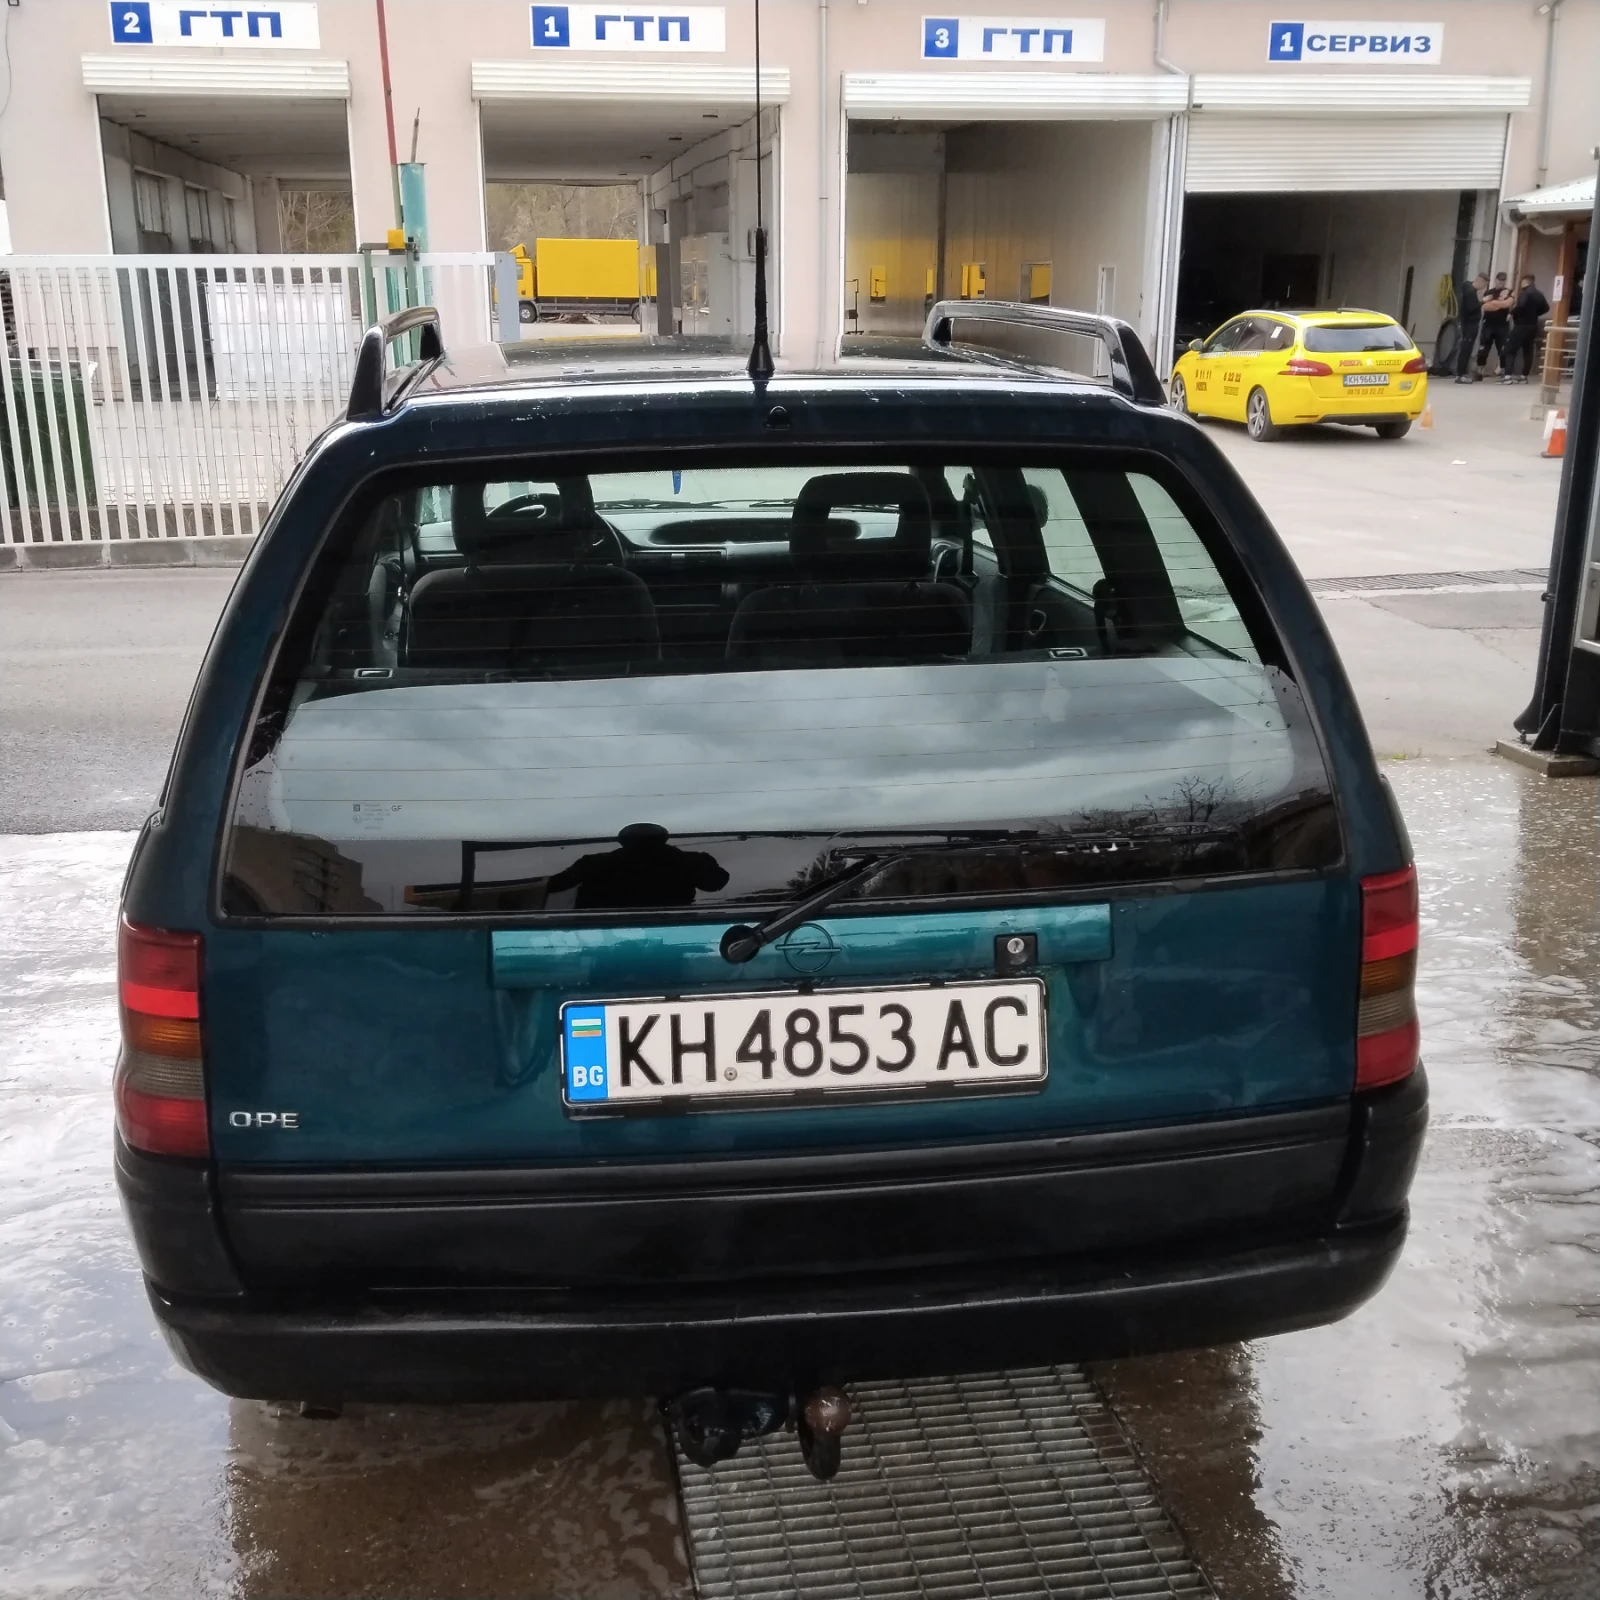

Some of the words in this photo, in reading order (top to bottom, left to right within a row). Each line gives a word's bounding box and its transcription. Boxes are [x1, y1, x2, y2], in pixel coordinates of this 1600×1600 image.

[123, 11, 141, 34] 2
[179, 10, 282, 38] ГТП
[544, 15, 560, 38] 1
[595, 14, 690, 42] ГТП
[934, 27, 950, 49] 3
[982, 27, 1073, 54] ГТП
[1279, 31, 1295, 52] 1
[1306, 34, 1432, 54] СЕРВИЗ
[618, 1012, 716, 1087] KH
[735, 1003, 917, 1080] 4853
[936, 995, 1029, 1071] AC
[572, 1065, 604, 1088] BG
